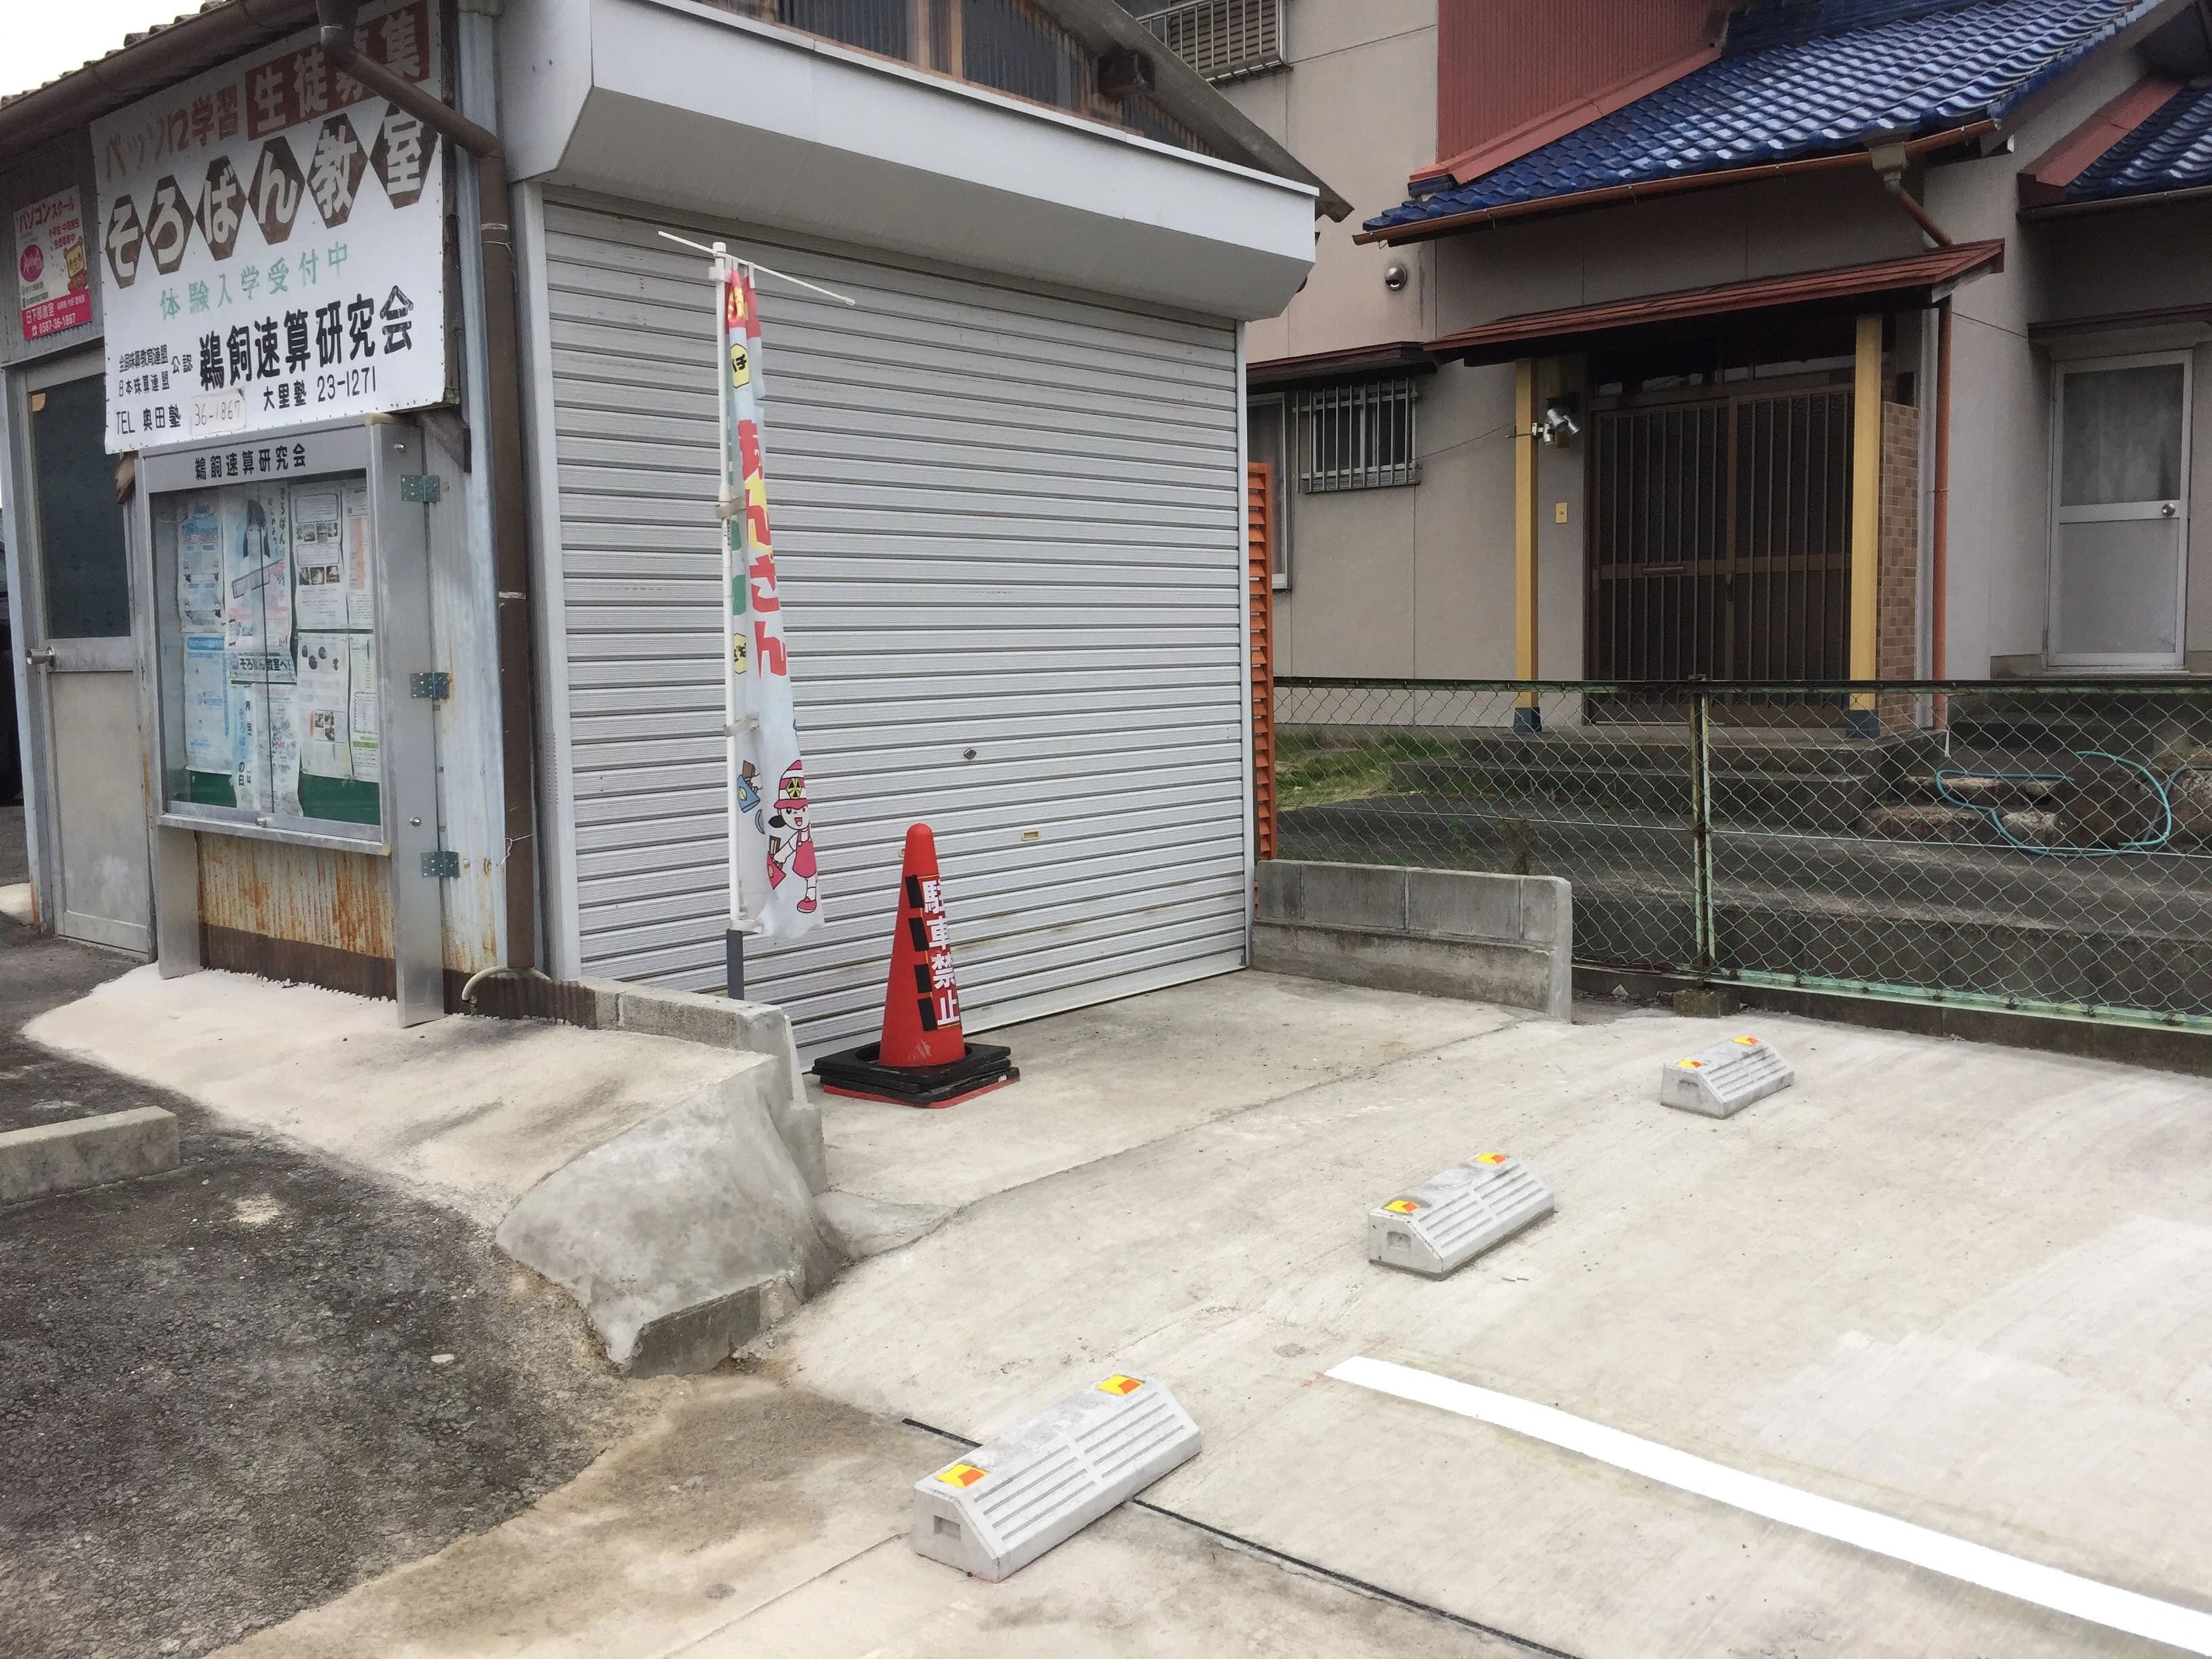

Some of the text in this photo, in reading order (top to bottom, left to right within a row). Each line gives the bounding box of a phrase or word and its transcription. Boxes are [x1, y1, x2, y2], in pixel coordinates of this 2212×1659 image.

[108, 112, 423, 277] そろばん教室
[160, 241, 348, 321] 体験入学受付中
[199, 285, 414, 391] 鵜飼速算研究会
[116, 366, 376, 434] TEL 奥田塾 36-1867 大里塾 23-1271
[119, 371, 169, 396] 日本珠算連盟
[195, 443, 306, 480] 鵜飼速算研究会
[922, 879, 960, 1026] 駐車禁止
